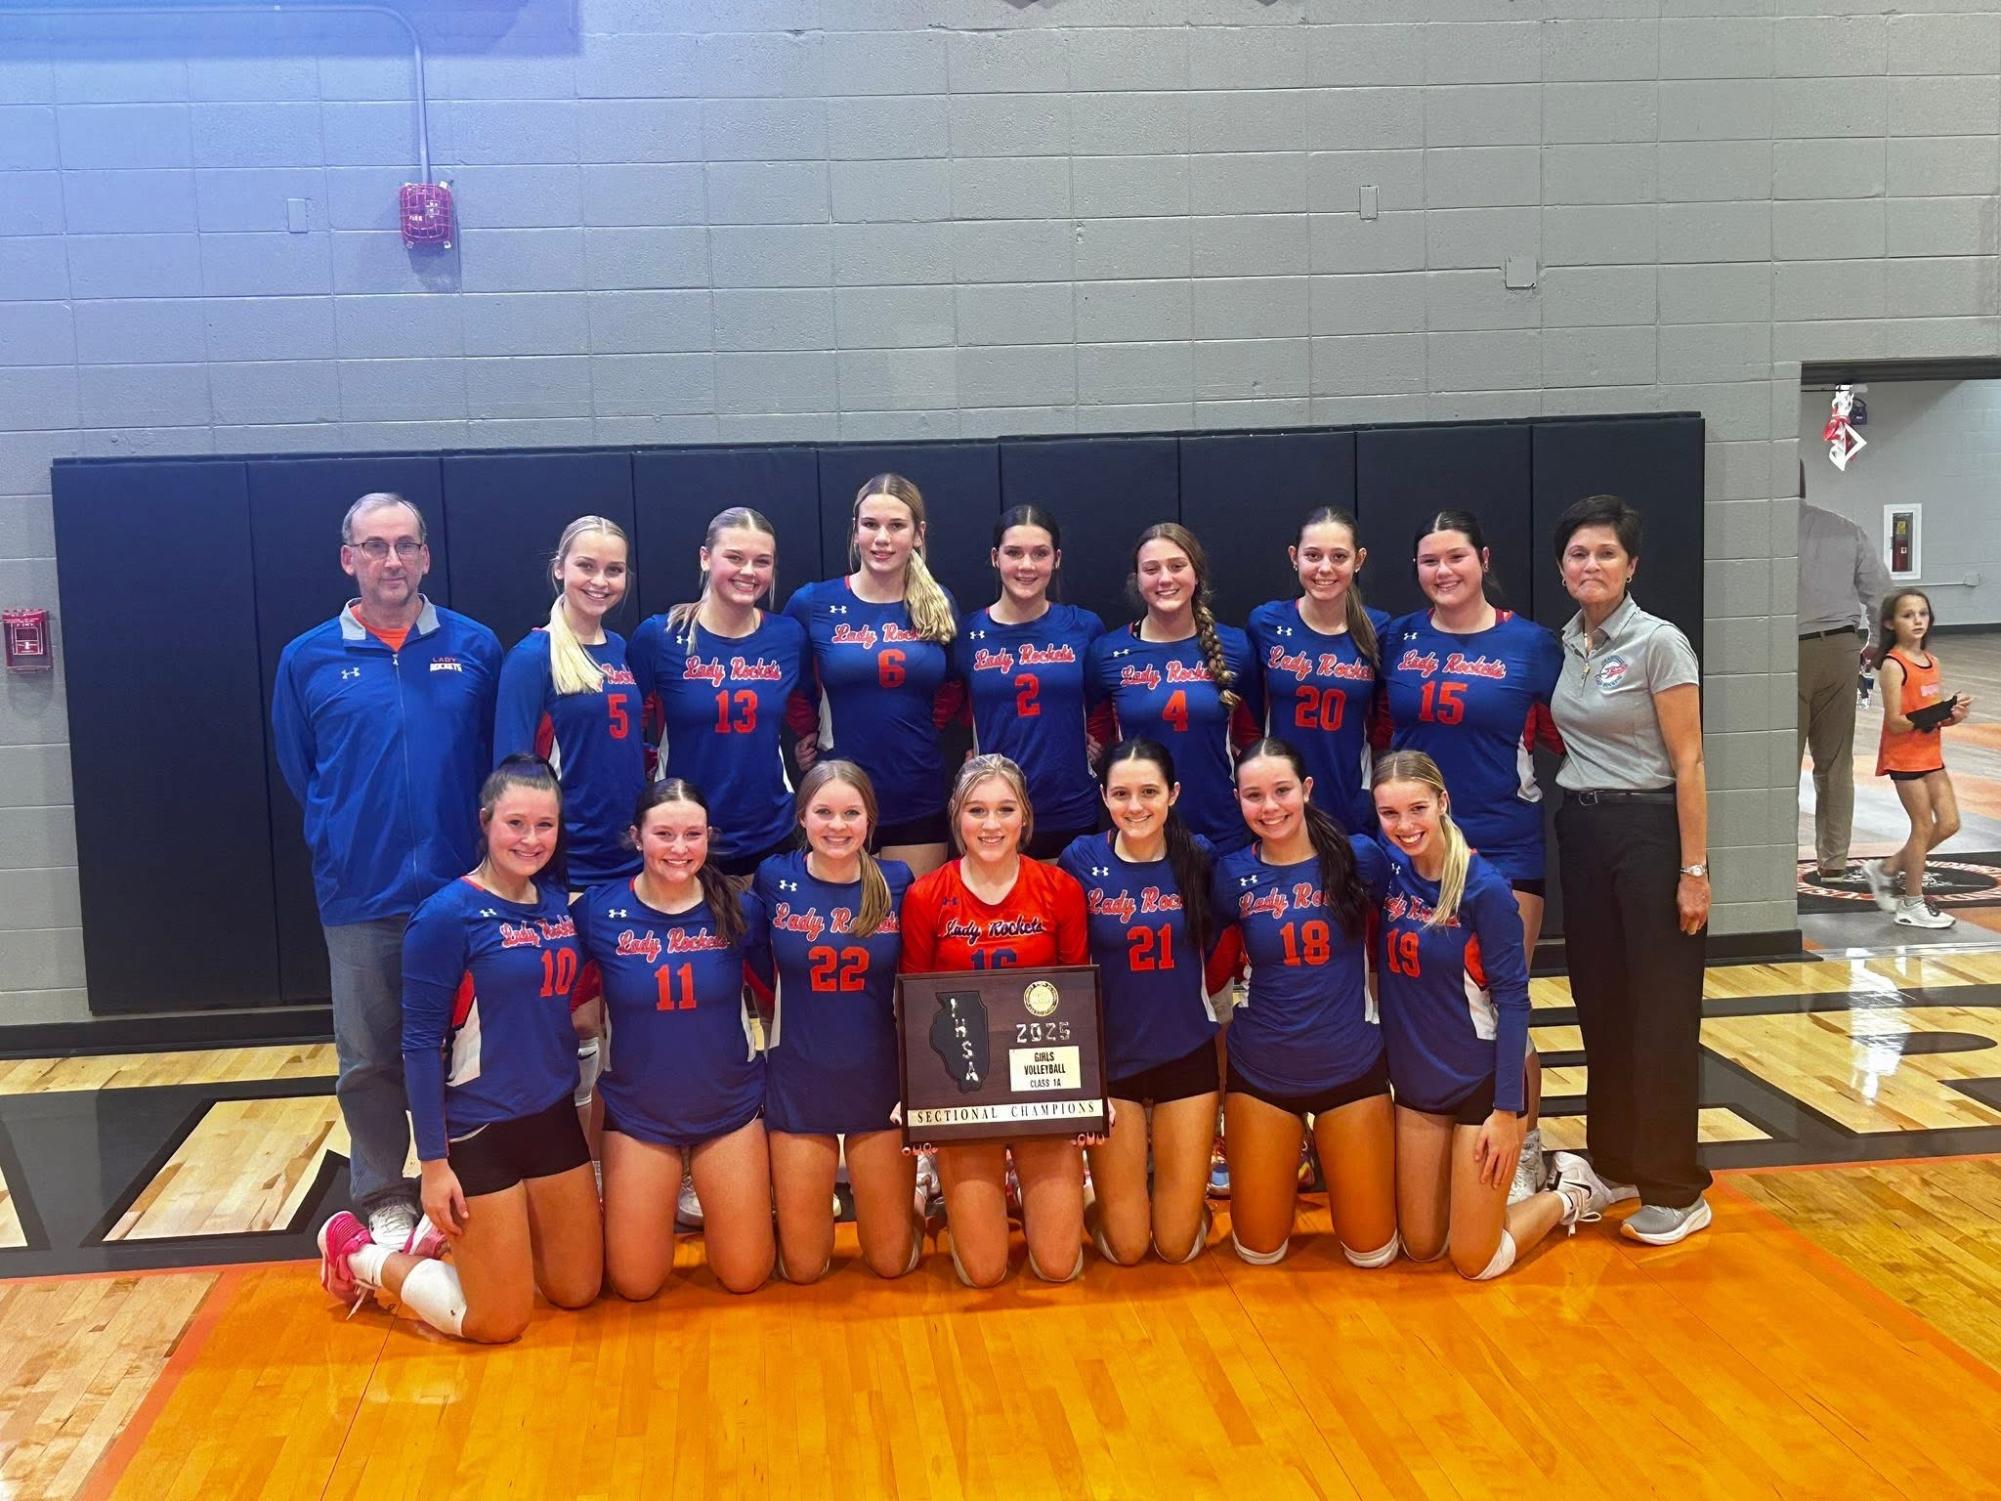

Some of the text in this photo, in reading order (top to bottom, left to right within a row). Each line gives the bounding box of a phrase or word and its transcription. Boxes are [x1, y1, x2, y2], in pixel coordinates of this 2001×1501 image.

[831, 623, 877, 649] Lady
[683, 656, 782, 688] Lady Rockets
[878, 648, 906, 689] 6
[974, 643, 1076, 674] Lady Rockets
[1268, 645, 1312, 681] Lady
[1397, 649, 1506, 679] Lady Rockets
[1120, 664, 1161, 690] Lady
[715, 689, 758, 733] 13
[1014, 673, 1041, 718] 2
[1162, 689, 1189, 732] 4
[1295, 685, 1347, 732] 20
[1418, 680, 1469, 726] 15
[608, 693, 628, 740] 5
[1088, 887, 1137, 924] Lady
[1239, 887, 1289, 919] Lady
[499, 921, 541, 948] Lady
[773, 902, 825, 942] Lady
[943, 914, 1047, 947] Lady Rockets
[615, 929, 662, 963] Lady
[1126, 923, 1175, 972] 21
[1280, 919, 1330, 967] 18
[1386, 927, 1421, 978] 19
[540, 947, 577, 997] 10
[653, 962, 697, 1011] 11
[808, 945, 870, 992] 22
[1016, 1021, 1071, 1044] 2025
[1024, 1062, 1067, 1076] VOLLEYBALL
[1034, 1051, 1056, 1062] GIRLS
[1030, 1078, 1062, 1089] CLASS 1A
[917, 1101, 1096, 1124] SECTIONAL CHAMPIONS
